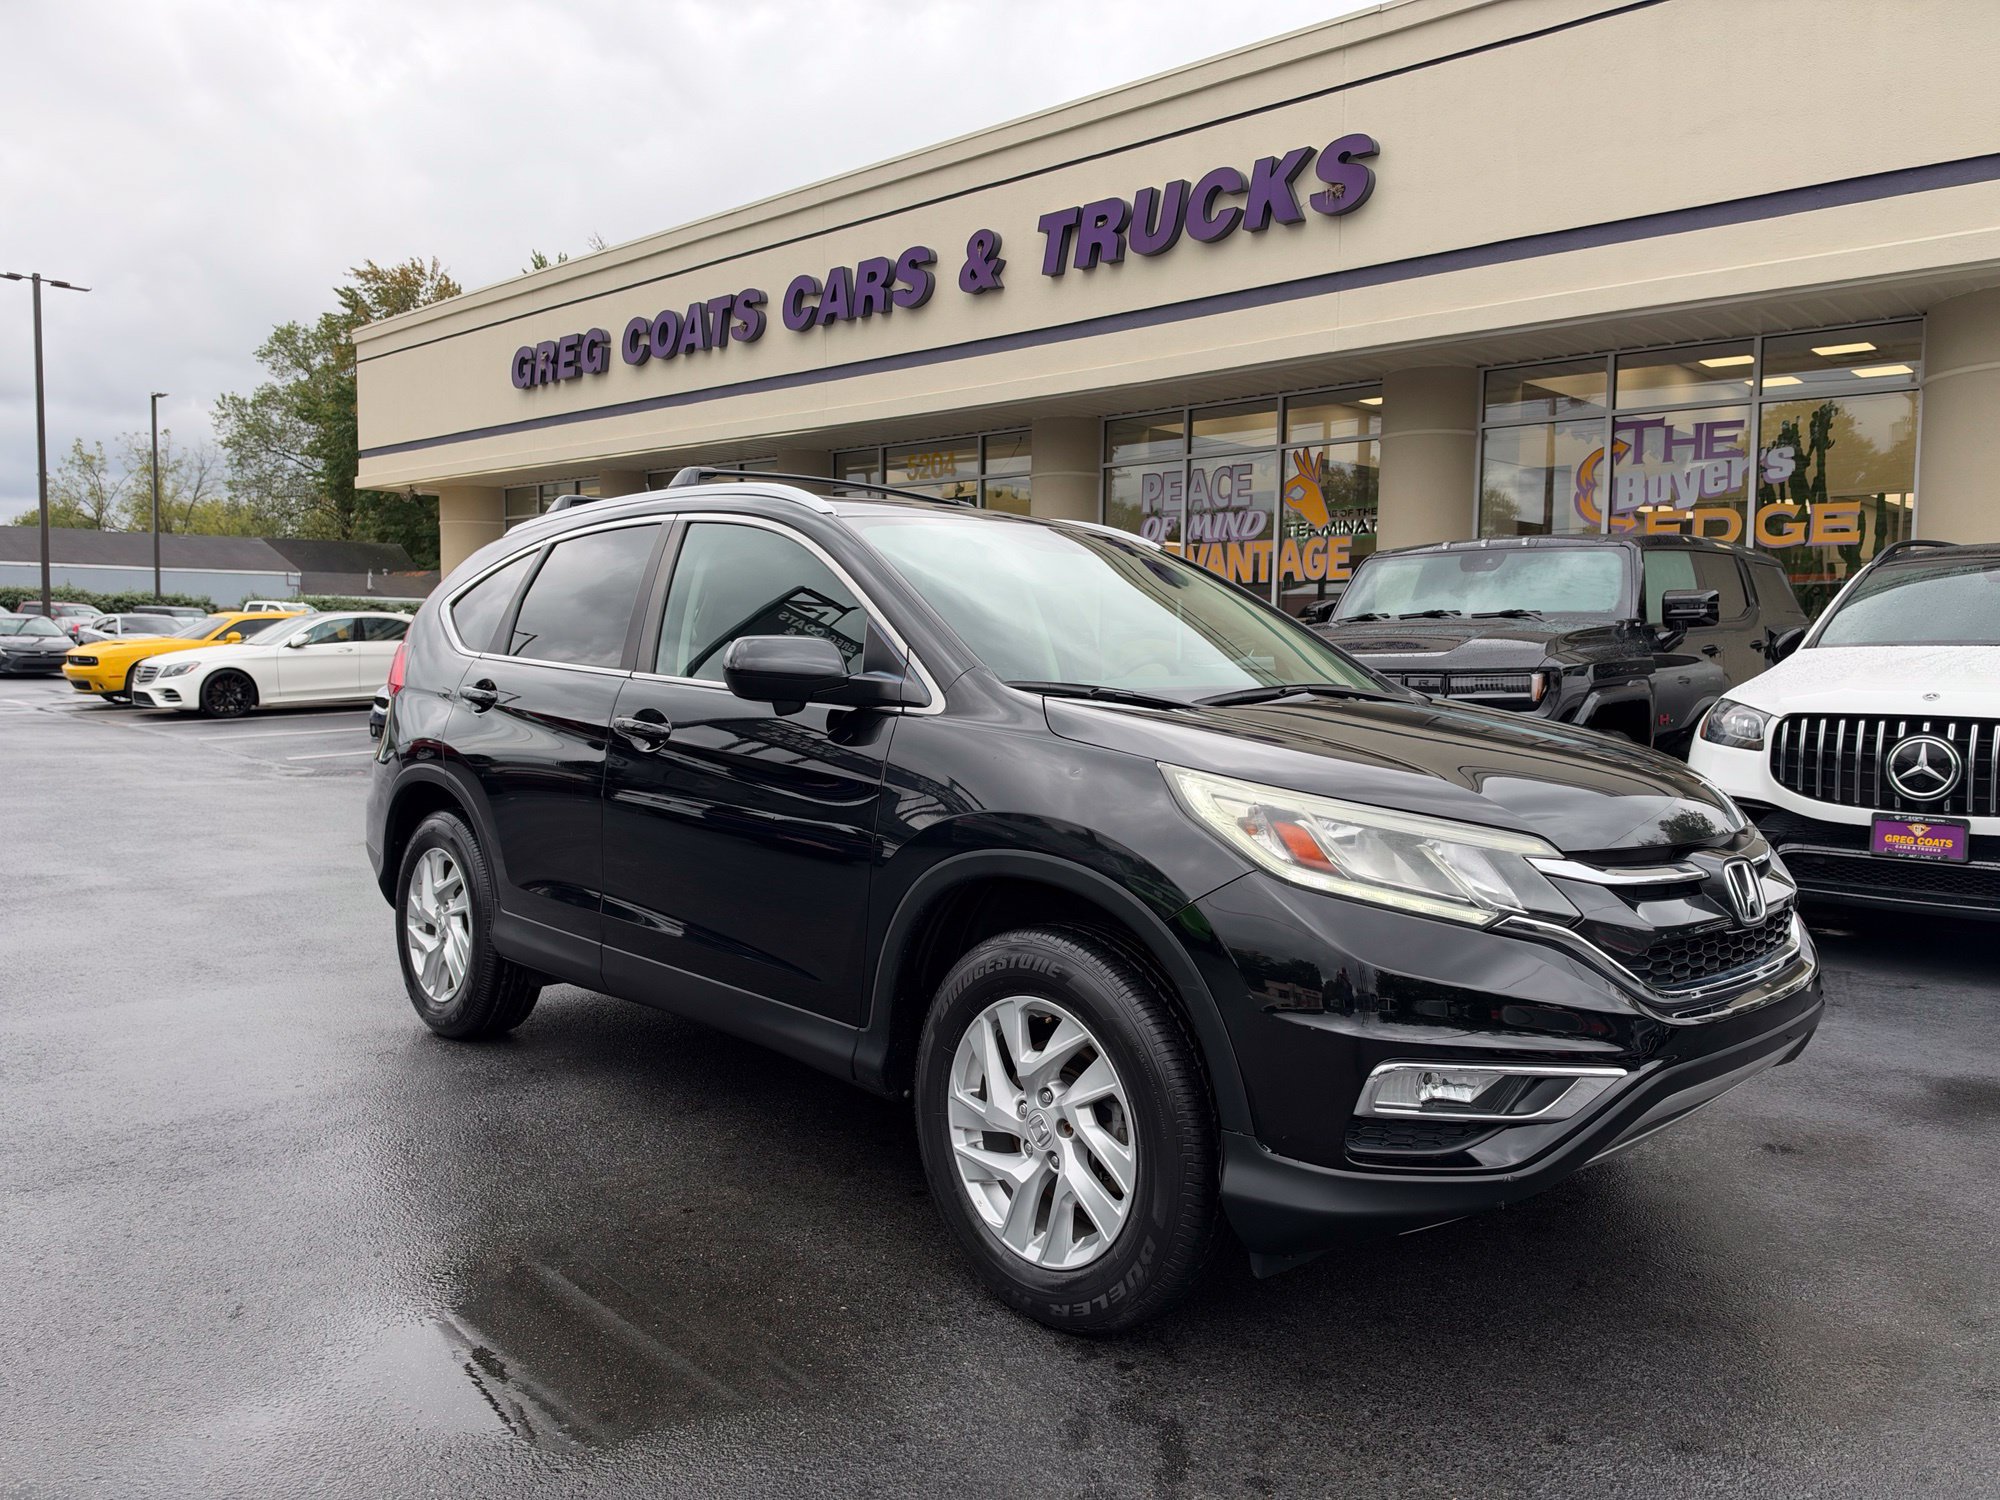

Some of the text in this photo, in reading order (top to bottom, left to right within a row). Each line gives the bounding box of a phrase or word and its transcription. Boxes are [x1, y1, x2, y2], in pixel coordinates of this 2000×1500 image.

[511, 133, 1380, 390] GREG COATS CARS & TRUCKS
[1614, 416, 1745, 465] THE
[906, 451, 957, 481] 5204
[1141, 464, 1253, 514] PEACE
[1140, 510, 1267, 542] OF MIND
[1286, 518, 1378, 537] TERMINAT
[1356, 507, 1378, 517] THE
[1644, 501, 1861, 549] EDGE
[1163, 535, 1353, 584] VANTAGE
[1884, 834, 1953, 848] GREG COATS
[937, 953, 1064, 1022] BRIDGESTONE
